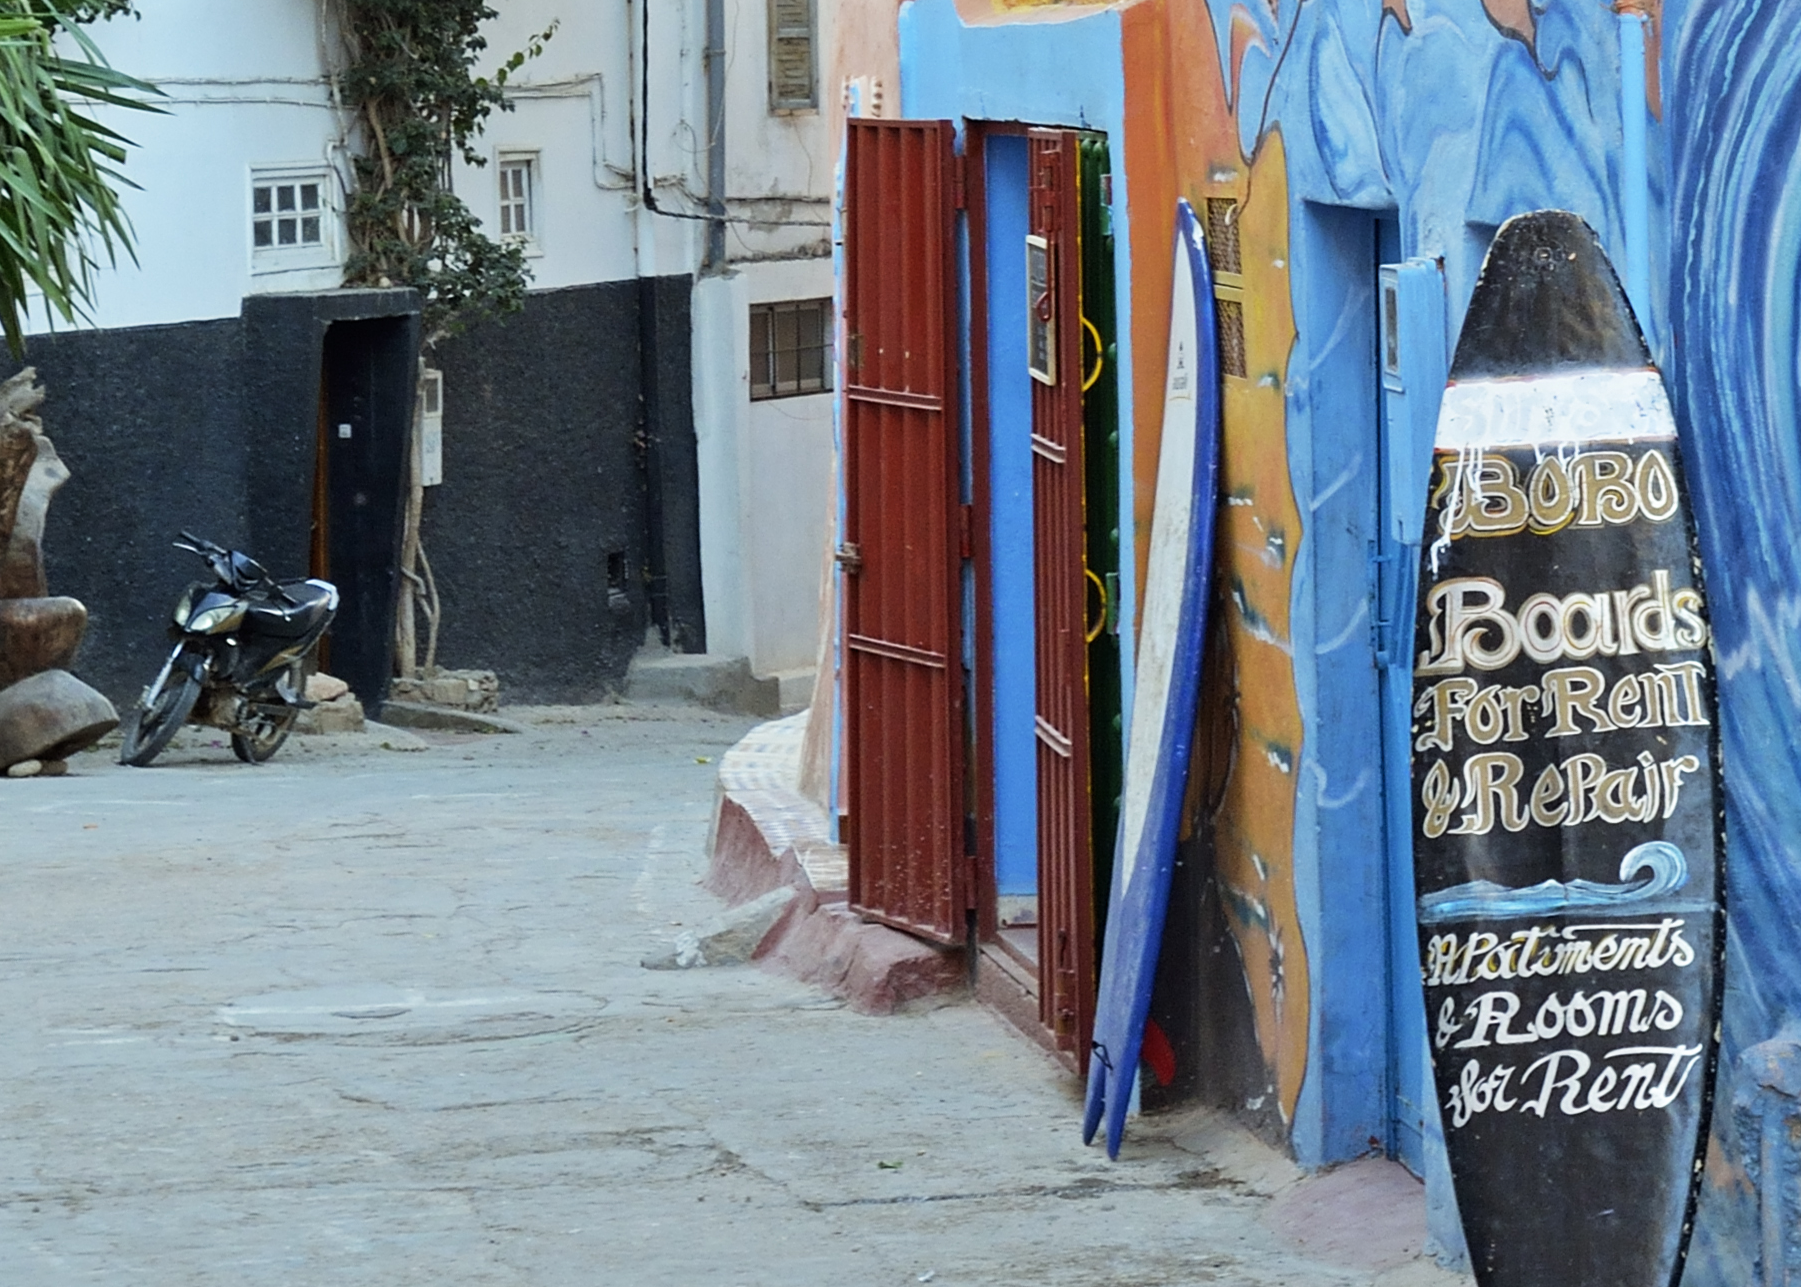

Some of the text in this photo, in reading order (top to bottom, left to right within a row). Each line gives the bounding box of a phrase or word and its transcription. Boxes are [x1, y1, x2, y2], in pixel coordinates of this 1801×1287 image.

[1433, 449, 1679, 539] BOBO
[1415, 570, 1708, 676] Boards
[1414, 677, 1540, 751] For
[1453, 989, 1683, 1048] Rooms
[1519, 1043, 1703, 1118] Rent
